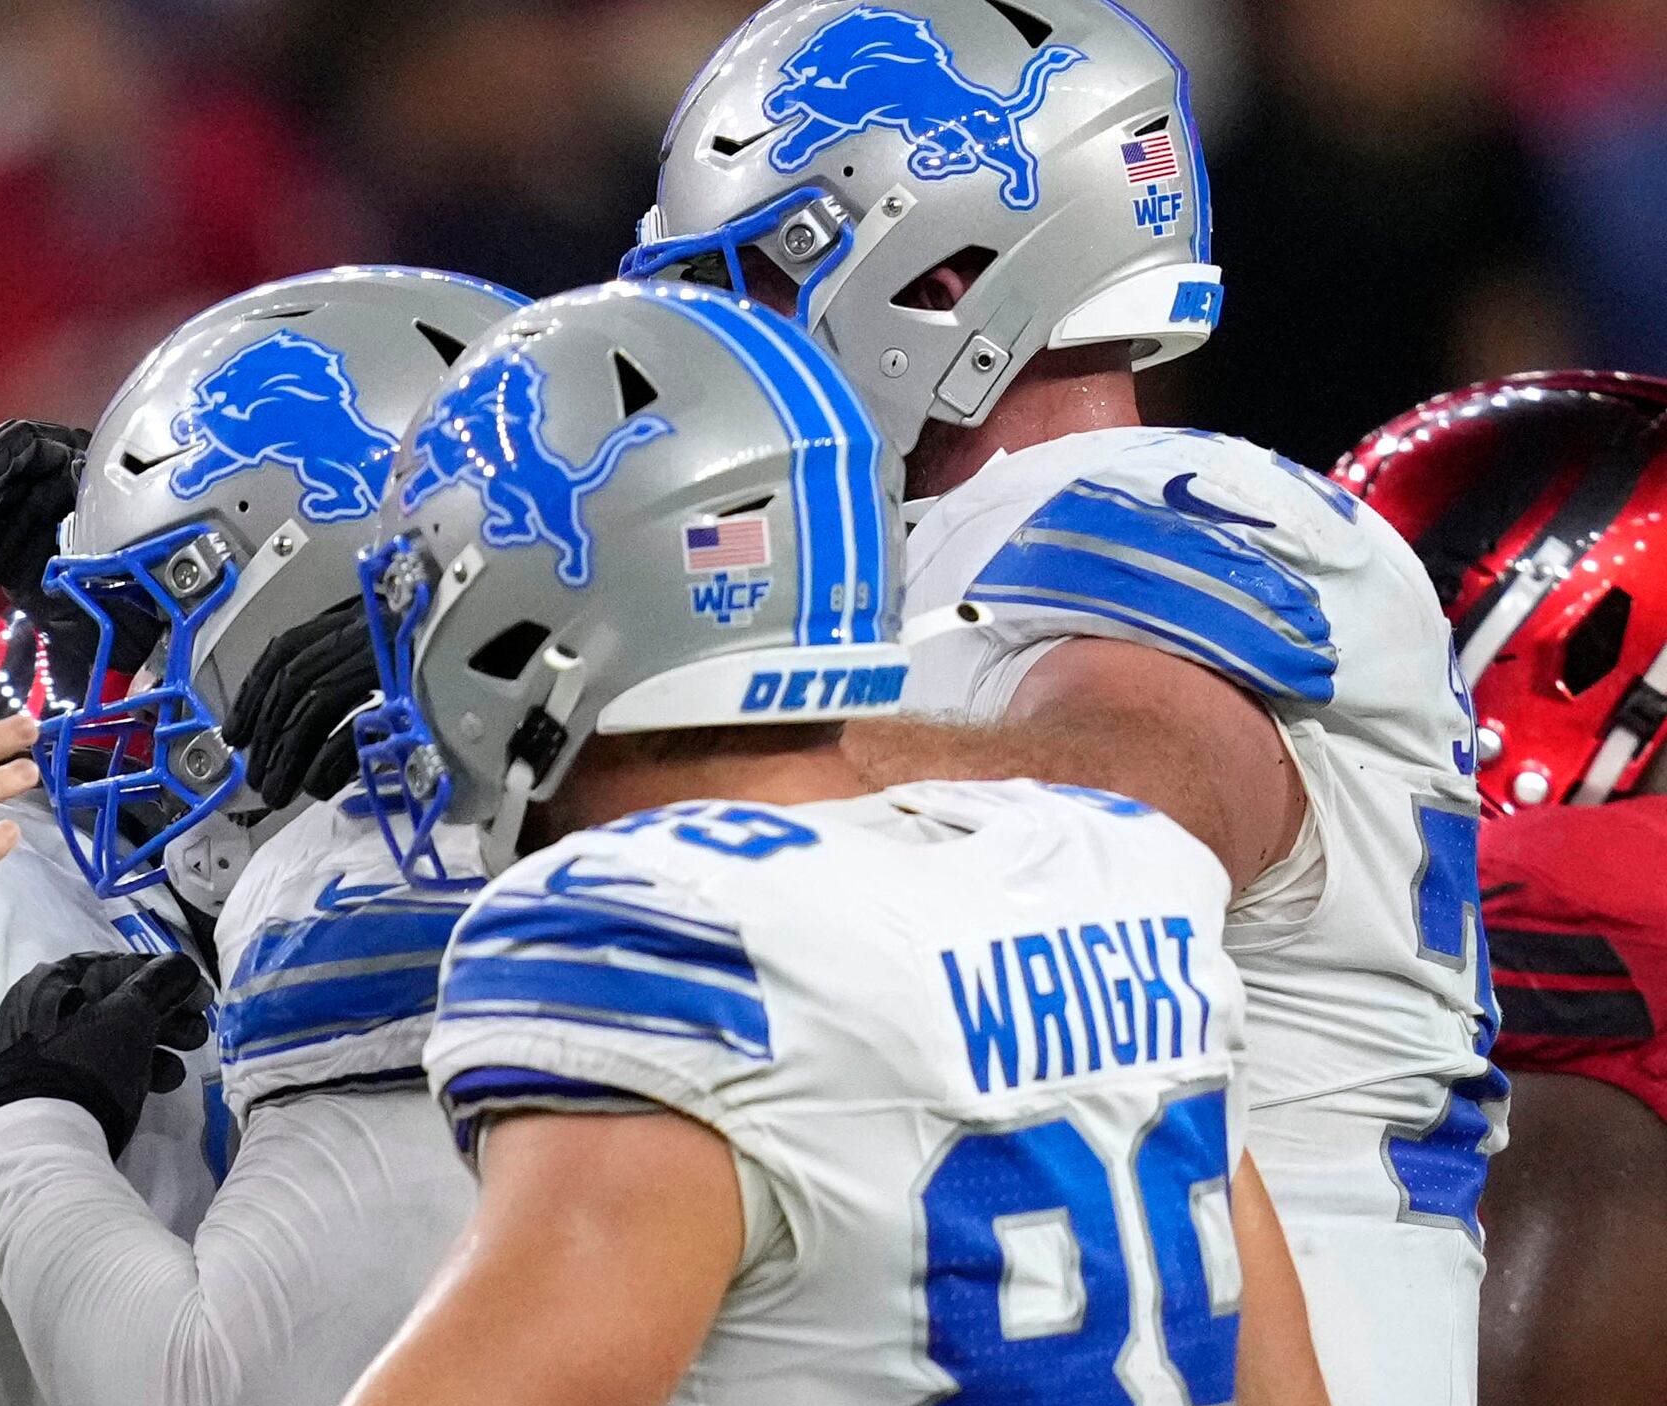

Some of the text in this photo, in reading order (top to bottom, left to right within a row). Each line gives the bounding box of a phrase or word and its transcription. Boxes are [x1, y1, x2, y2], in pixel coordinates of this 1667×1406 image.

[1132, 191, 1184, 227] WCF
[692, 580, 770, 614] WCF
[940, 915, 1210, 1094] WRIGHT
